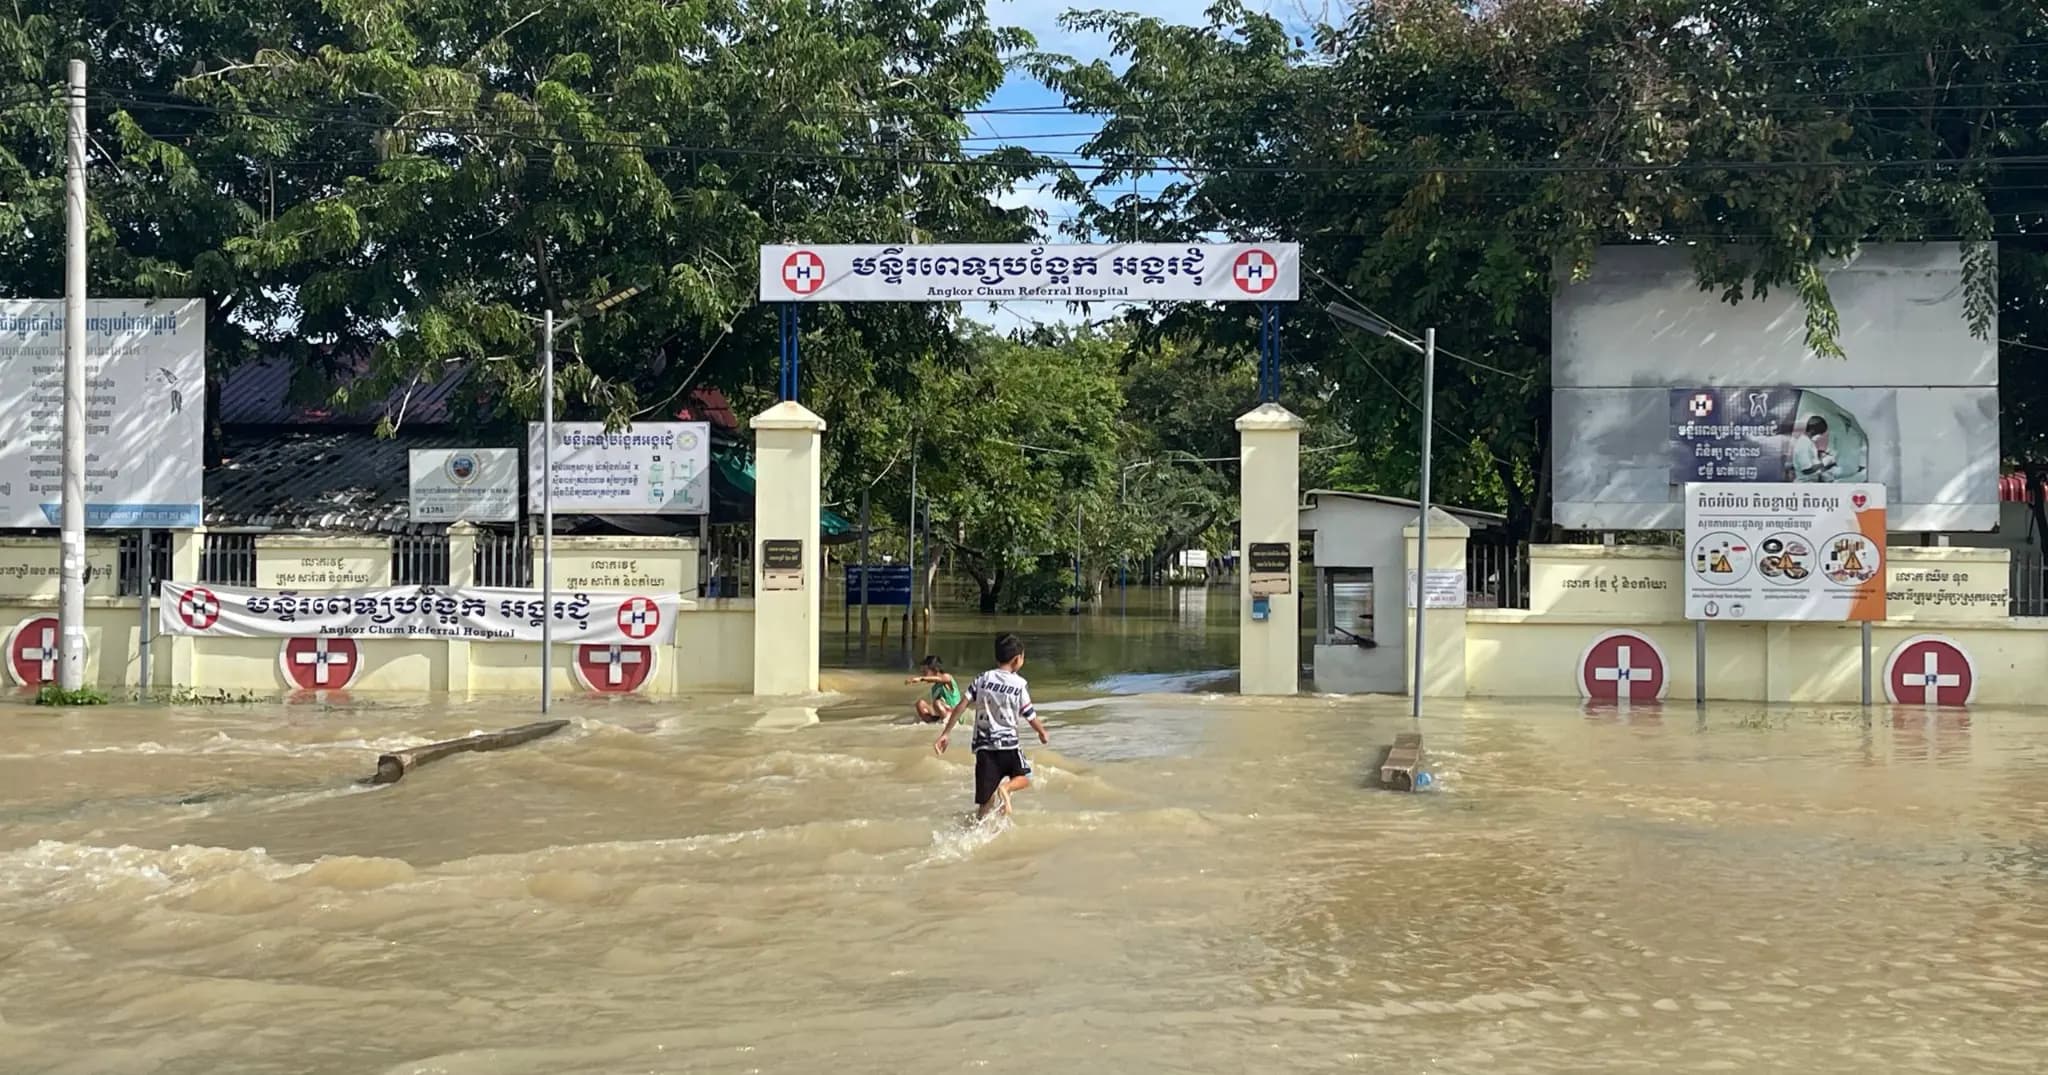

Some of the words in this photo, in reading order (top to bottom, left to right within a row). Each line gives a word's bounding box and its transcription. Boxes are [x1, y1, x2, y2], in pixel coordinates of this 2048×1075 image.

[797, 266, 810, 279] H
[853, 247, 1097, 285] មន្ទីរពេទ្យបង្អែក
[1113, 247, 1204, 286] អង្គរជុំ
[1248, 265, 1262, 278] H
[927, 286, 974, 298] Angkor
[977, 286, 1014, 296] Chum
[1019, 286, 1071, 296] Referral
[1075, 286, 1128, 297] Hospital
[632, 612, 645, 623] H
[320, 625, 365, 636] Angkor
[369, 625, 405, 634] Chum
[408, 625, 459, 636] Referral
[464, 626, 515, 639] Hospital
[981, 679, 1021, 697] LABUBU
